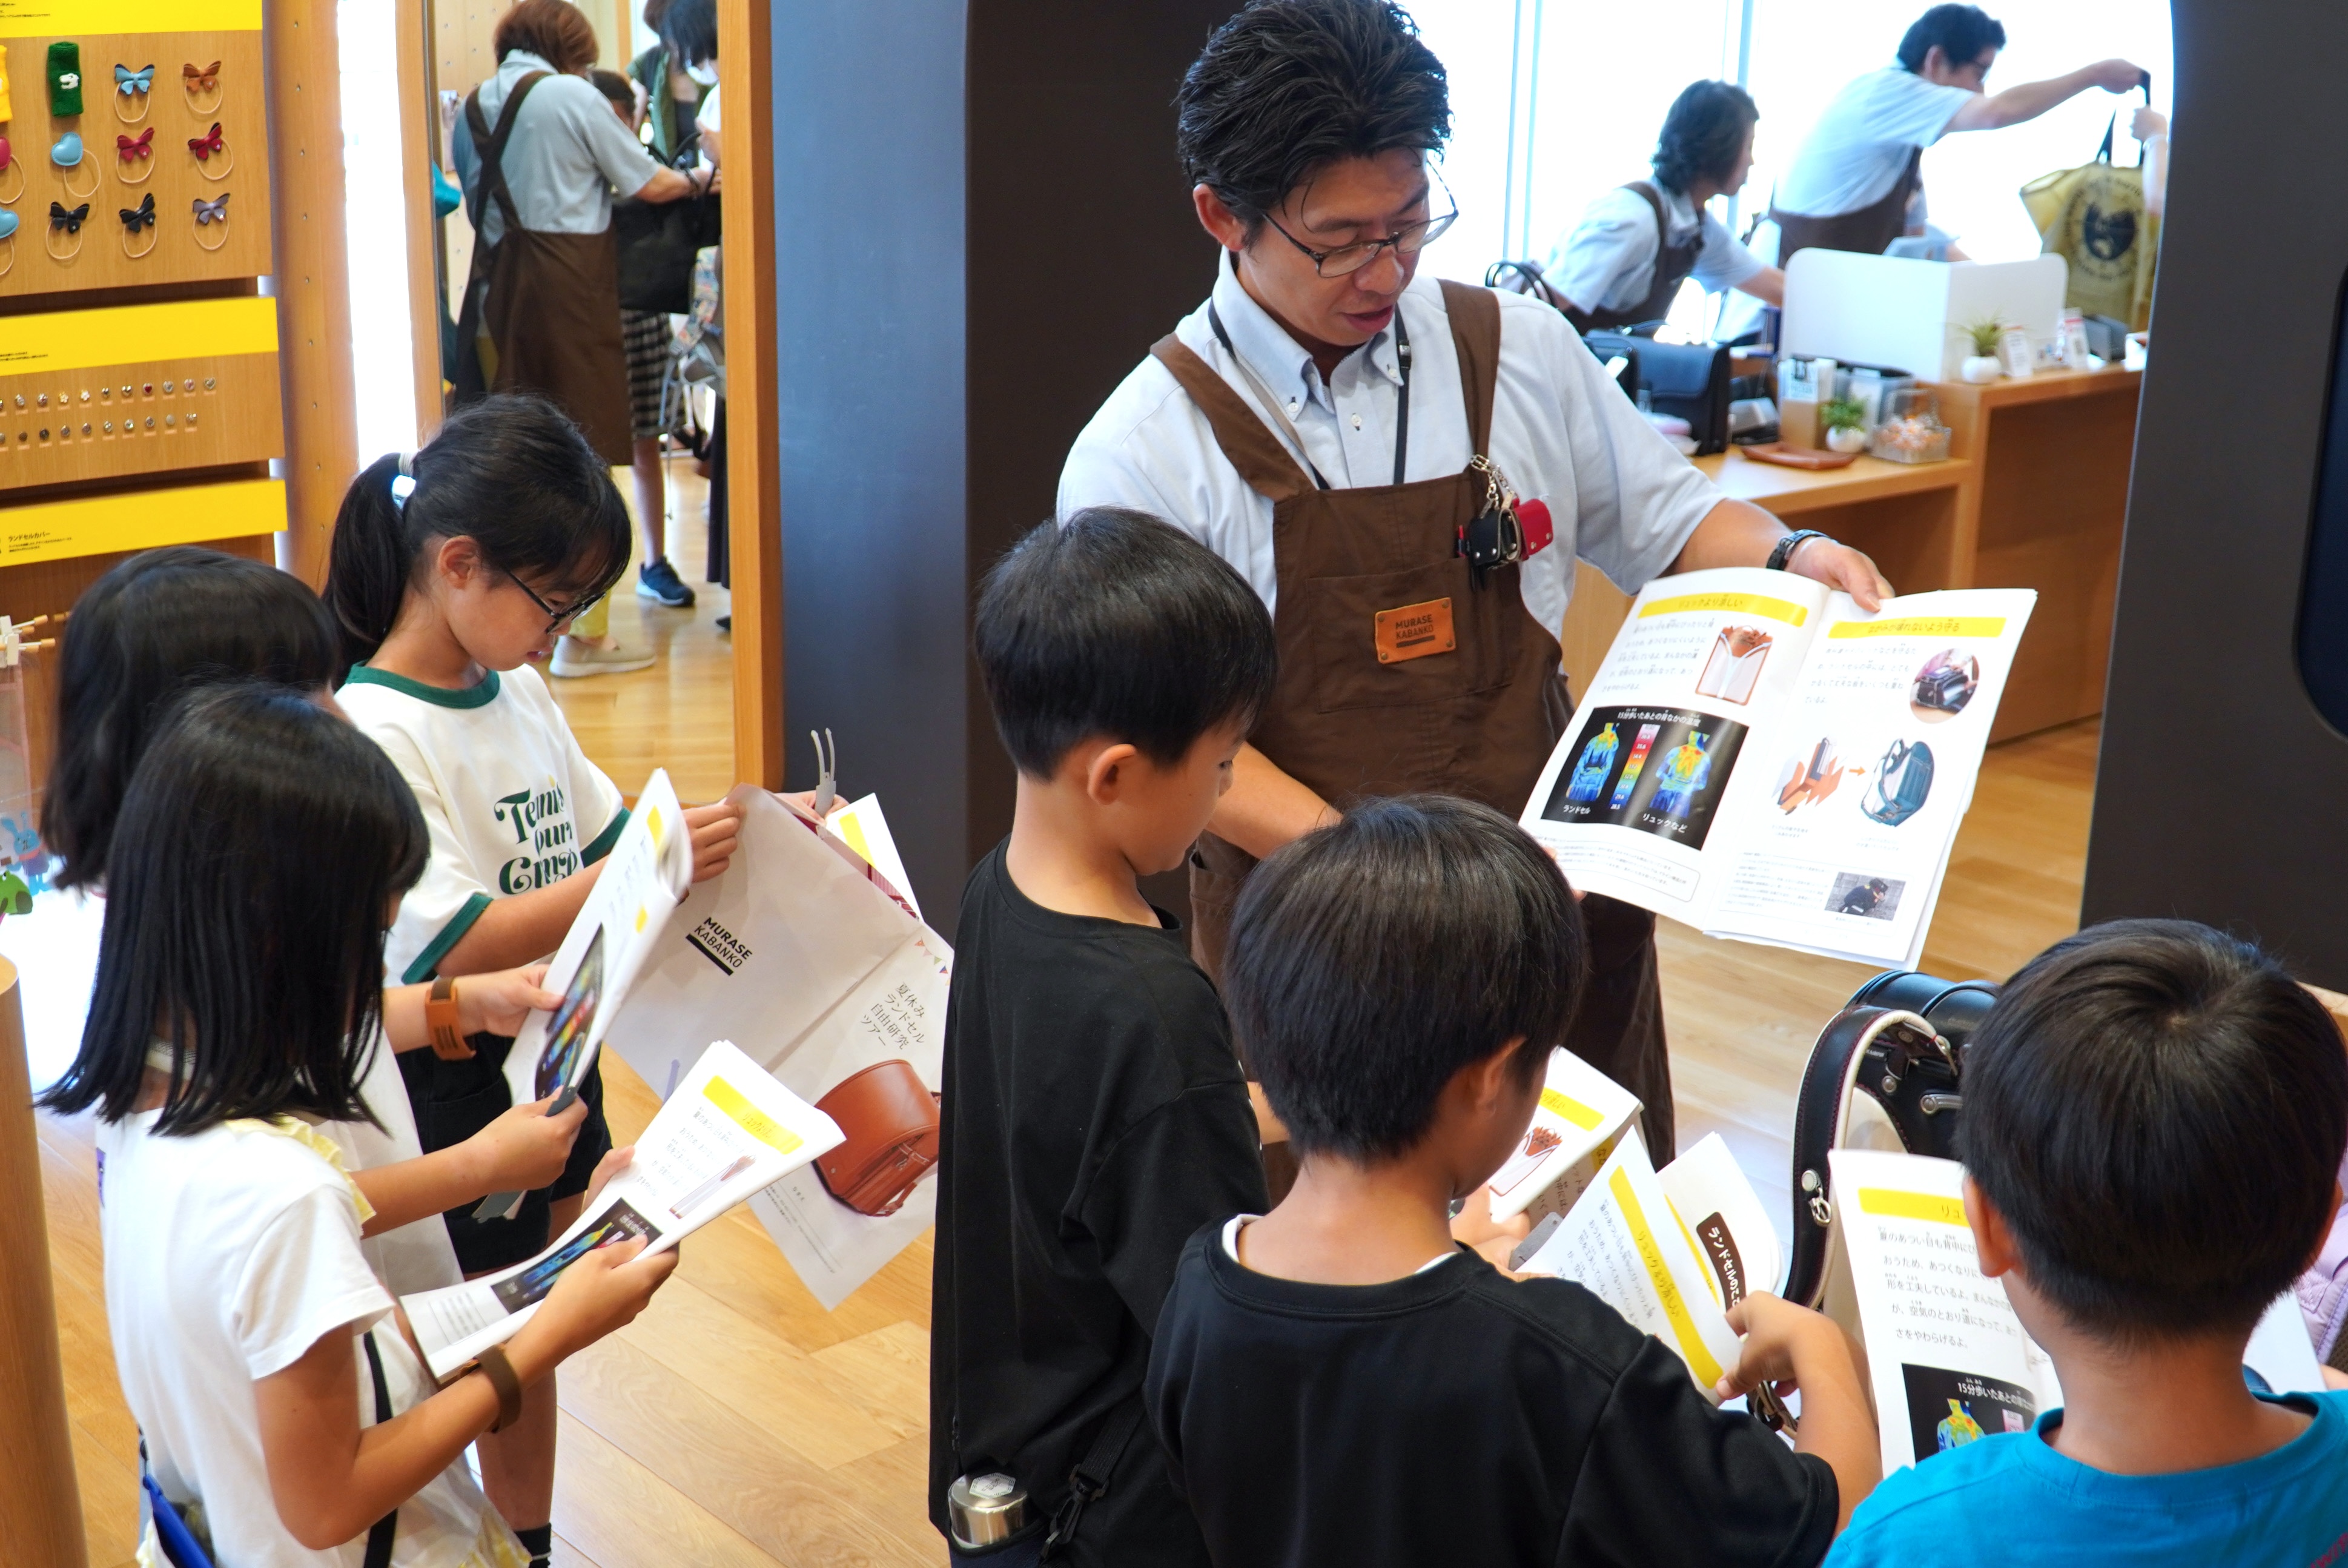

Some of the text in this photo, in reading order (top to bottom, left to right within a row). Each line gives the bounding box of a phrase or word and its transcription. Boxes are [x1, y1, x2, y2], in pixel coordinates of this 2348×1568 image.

[1396, 614, 1433, 629] MURASE
[1397, 625, 1434, 640] KABANKO
[1563, 804, 1591, 815] ランドセル
[1642, 813, 1687, 833] リュックなど
[694, 925, 743, 968] KABANKO
[703, 916, 753, 960] MURASE
[896, 981, 925, 1017] 夏休み
[860, 1014, 886, 1046] ツアー
[871, 1003, 909, 1050] 自由研究
[884, 993, 925, 1043] ランドセル
[1896, 1328, 1968, 1348] さをやわらげるよ。
